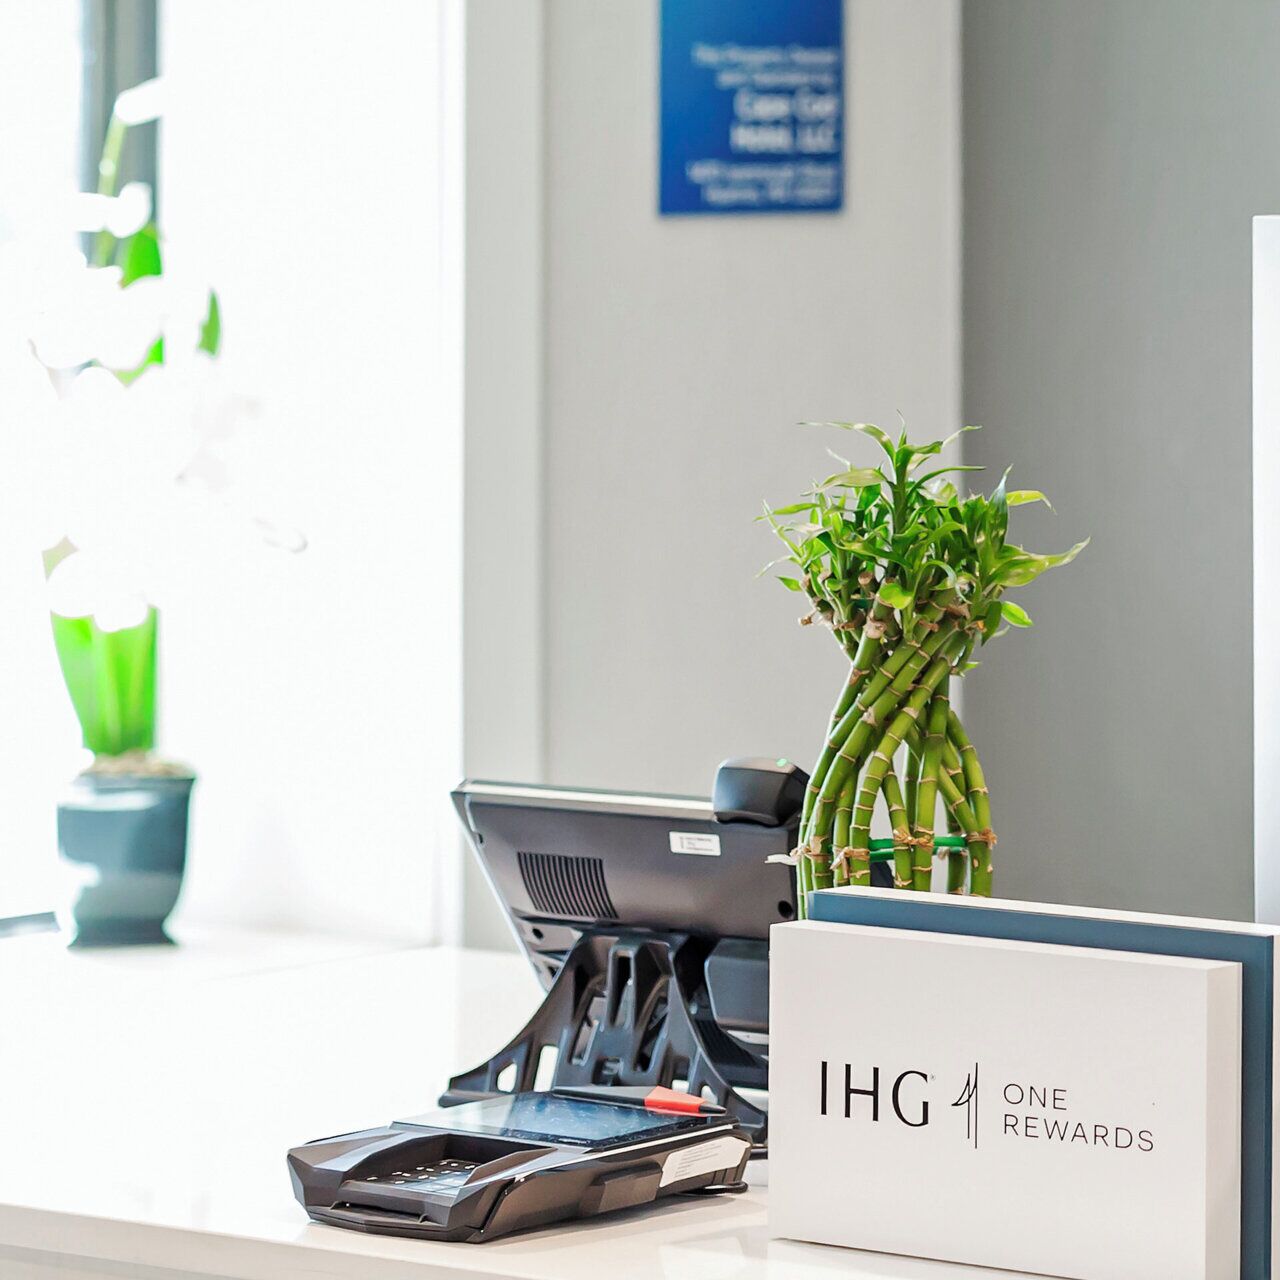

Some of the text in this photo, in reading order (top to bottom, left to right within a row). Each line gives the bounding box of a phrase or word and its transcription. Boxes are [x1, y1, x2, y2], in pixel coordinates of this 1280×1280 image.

[820, 1060, 930, 1128] IHG
[1003, 1083, 1068, 1111] ONE
[1003, 1113, 1155, 1152] REWARDS
